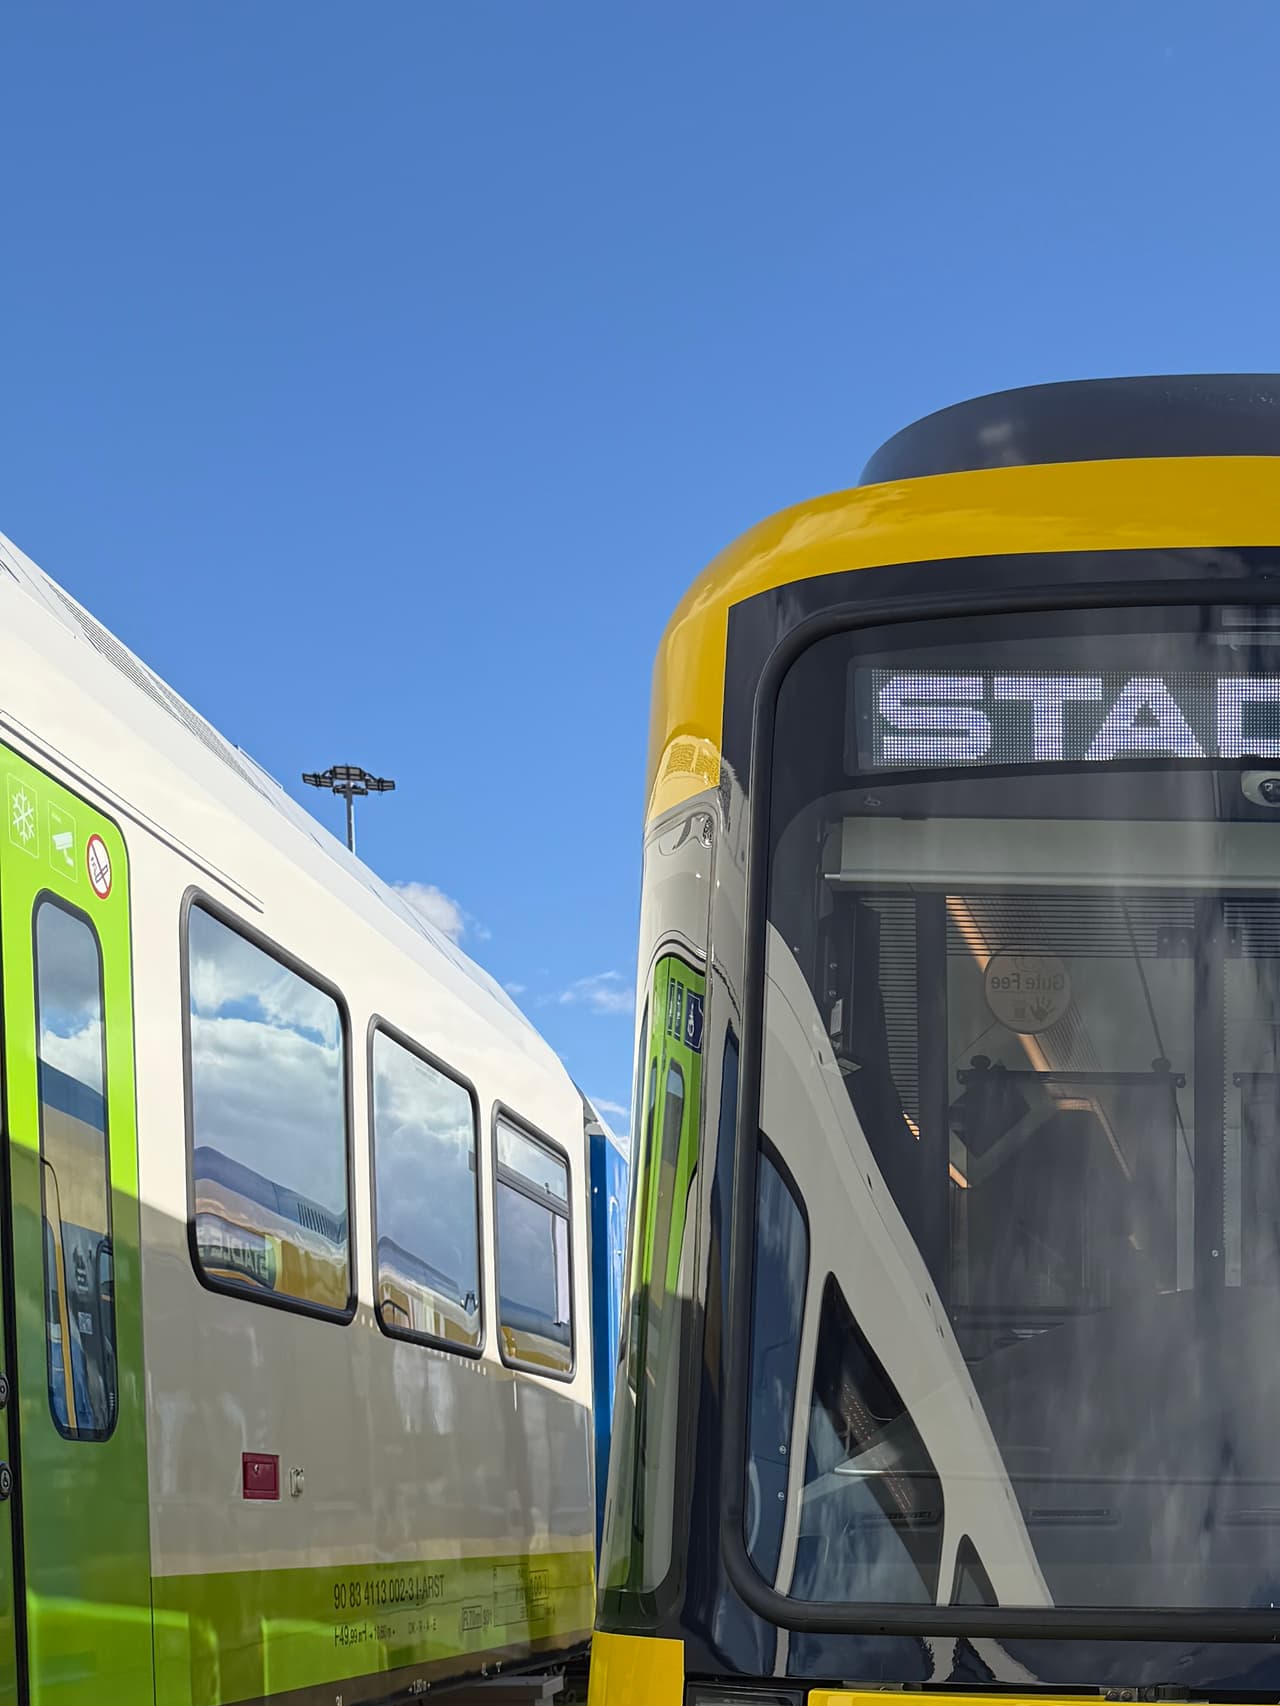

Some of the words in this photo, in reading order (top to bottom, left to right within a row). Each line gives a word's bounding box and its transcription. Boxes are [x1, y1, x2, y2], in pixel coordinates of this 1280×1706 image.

[334, 1583, 347, 1609] 90
[349, 1582, 361, 1607] 83
[364, 1580, 387, 1605] 4113
